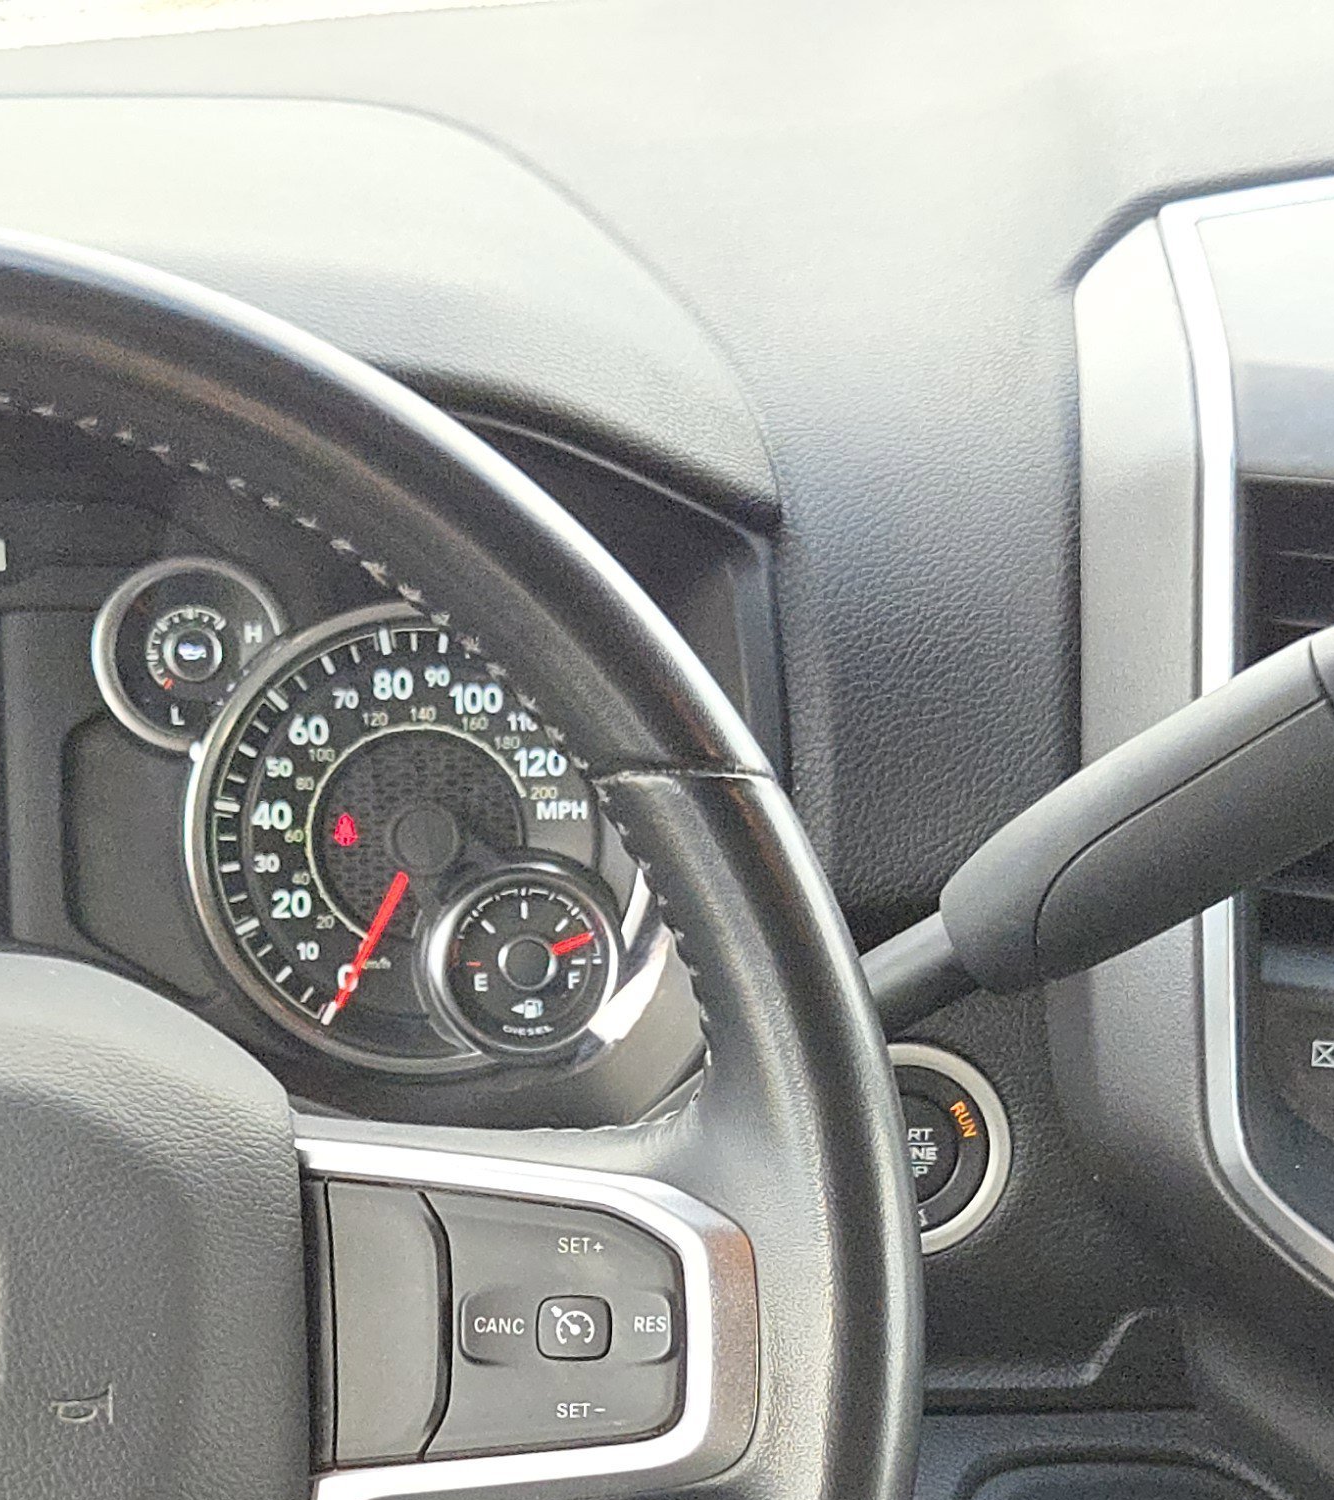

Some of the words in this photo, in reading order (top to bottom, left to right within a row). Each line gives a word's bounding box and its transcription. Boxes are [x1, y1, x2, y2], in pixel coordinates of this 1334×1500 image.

[244, 622, 263, 643] H
[373, 667, 414, 700] 80
[424, 665, 451, 687] 90
[332, 687, 359, 709] 70
[449, 682, 503, 714] 100
[170, 704, 185, 725] L
[363, 711, 388, 727] 120
[410, 706, 437, 722] 140
[288, 713, 329, 745] 60
[309, 748, 335, 762] 100
[513, 747, 567, 777] 120
[266, 757, 293, 778] 50
[530, 786, 558, 800] 200
[252, 801, 293, 830] 40
[536, 801, 588, 820] MPH
[284, 829, 304, 843] 60
[253, 853, 280, 873] 30
[271, 888, 312, 919] 20
[317, 915, 335, 929] 20
[296, 941, 320, 961] 10
[473, 973, 489, 992] E
[568, 970, 581, 990] F
[502, 1024, 555, 1036] DIESEL
[950, 1101, 977, 1138] RUN
[473, 1317, 525, 1335] CANC
[633, 1316, 667, 1333] RES
